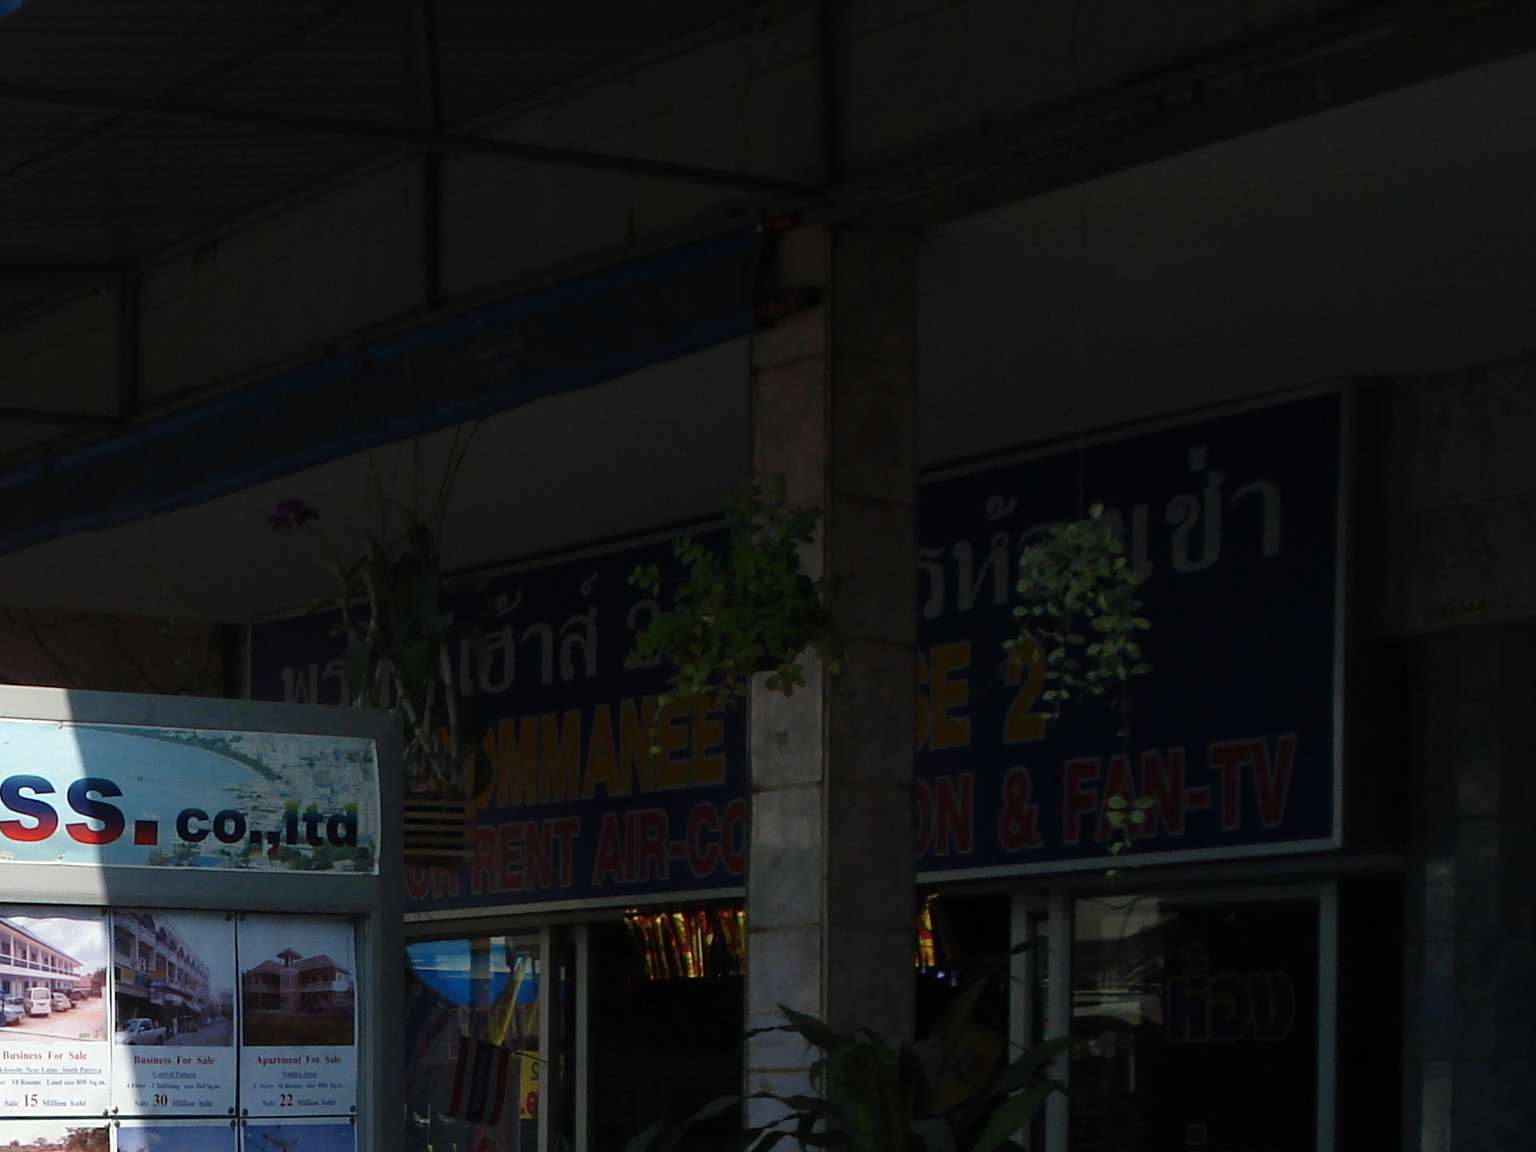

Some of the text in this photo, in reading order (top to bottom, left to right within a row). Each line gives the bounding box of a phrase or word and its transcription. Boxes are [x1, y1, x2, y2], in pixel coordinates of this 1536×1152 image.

[440, 692, 727, 808] OMMANEE
[1002, 638, 1047, 745] 2
[404, 850, 460, 900] OR
[470, 814, 581, 896] RENT
[998, 765, 1044, 854] &
[3, 1051, 87, 1060] Business For Sale
[134, 1055, 192, 1065] Business For
[256, 1056, 301, 1066] Apartment
[24, 1094, 38, 1107] 15
[153, 1094, 167, 1106] 30
[280, 1094, 293, 1106] 22
